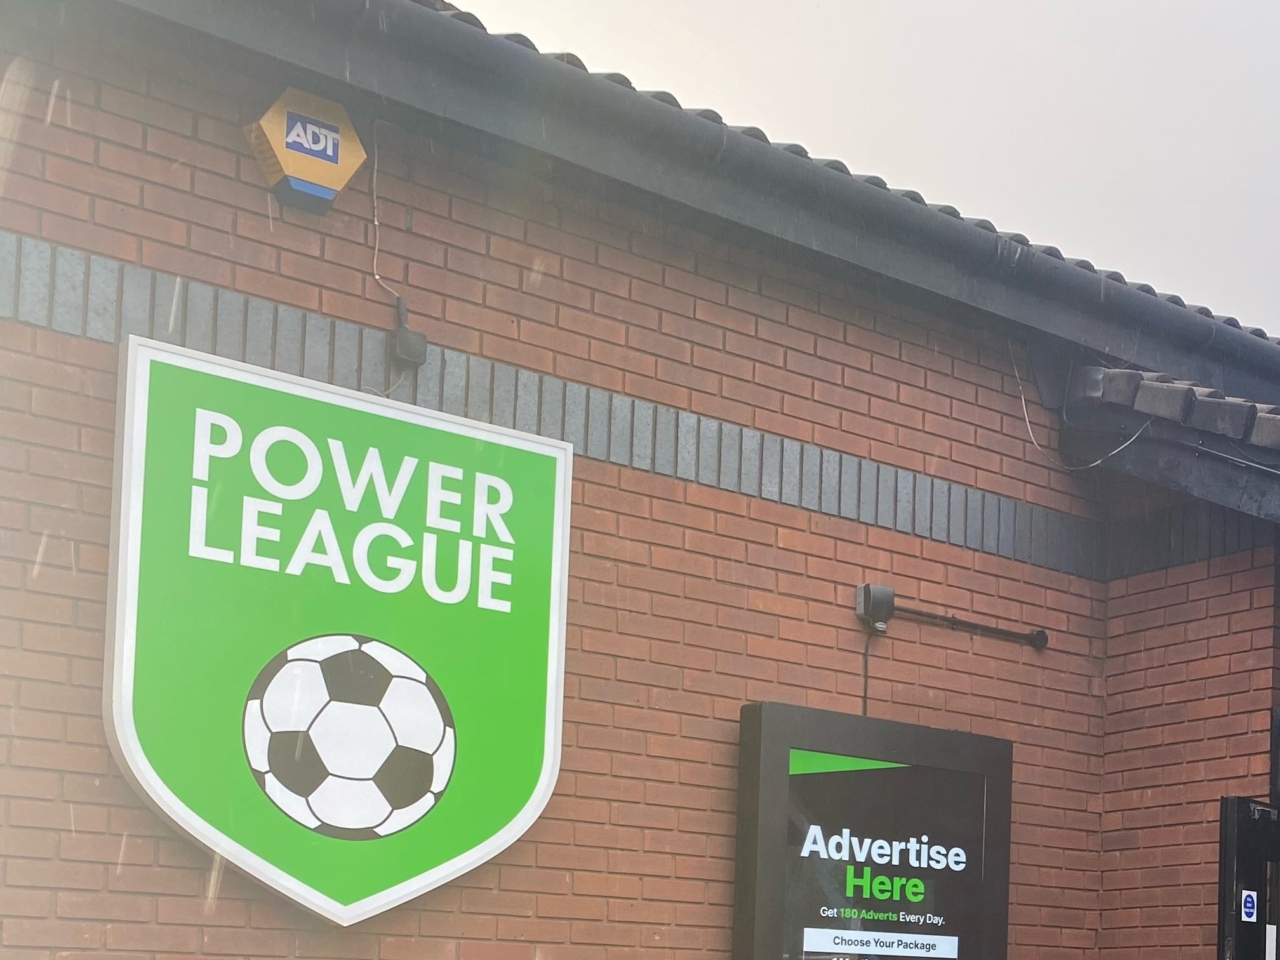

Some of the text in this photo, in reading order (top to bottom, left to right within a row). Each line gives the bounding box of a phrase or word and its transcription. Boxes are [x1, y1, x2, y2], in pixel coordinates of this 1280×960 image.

[284, 121, 341, 157] ADT
[192, 407, 515, 545] POWER
[188, 486, 513, 613] LEAGUE
[800, 825, 967, 872] Advertise
[845, 865, 926, 903] Here
[820, 906, 945, 926] Get 180 Adverts Every Day.
[833, 935, 937, 953] Choose Your Package
